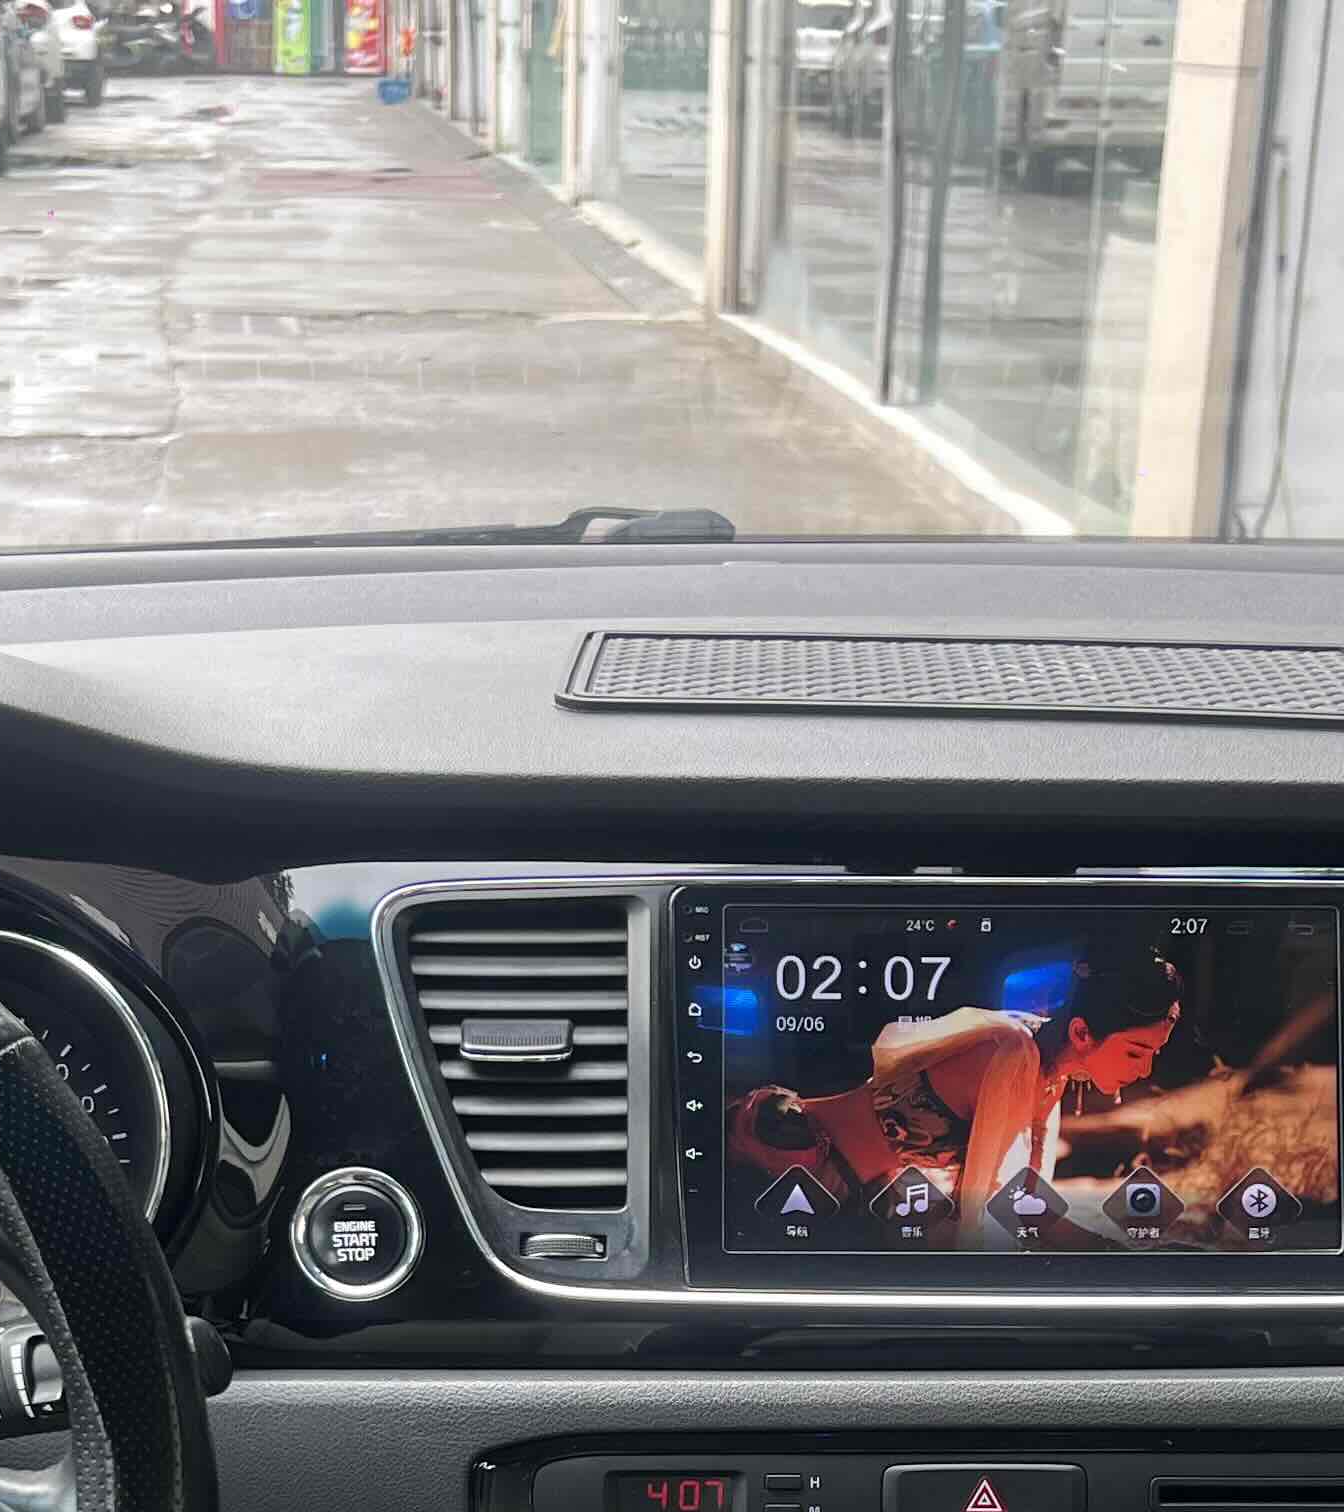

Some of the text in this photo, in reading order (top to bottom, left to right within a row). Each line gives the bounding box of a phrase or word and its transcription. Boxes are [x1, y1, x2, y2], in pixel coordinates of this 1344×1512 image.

[1170, 917, 1209, 934] 2:07
[776, 1016, 825, 1032] 09/06
[333, 1220, 376, 1232] ENGINE
[1016, 1226, 1040, 1239] 天气
[332, 1233, 378, 1248] START
[337, 1248, 375, 1262] STOP
[809, 1476, 821, 1489] H
